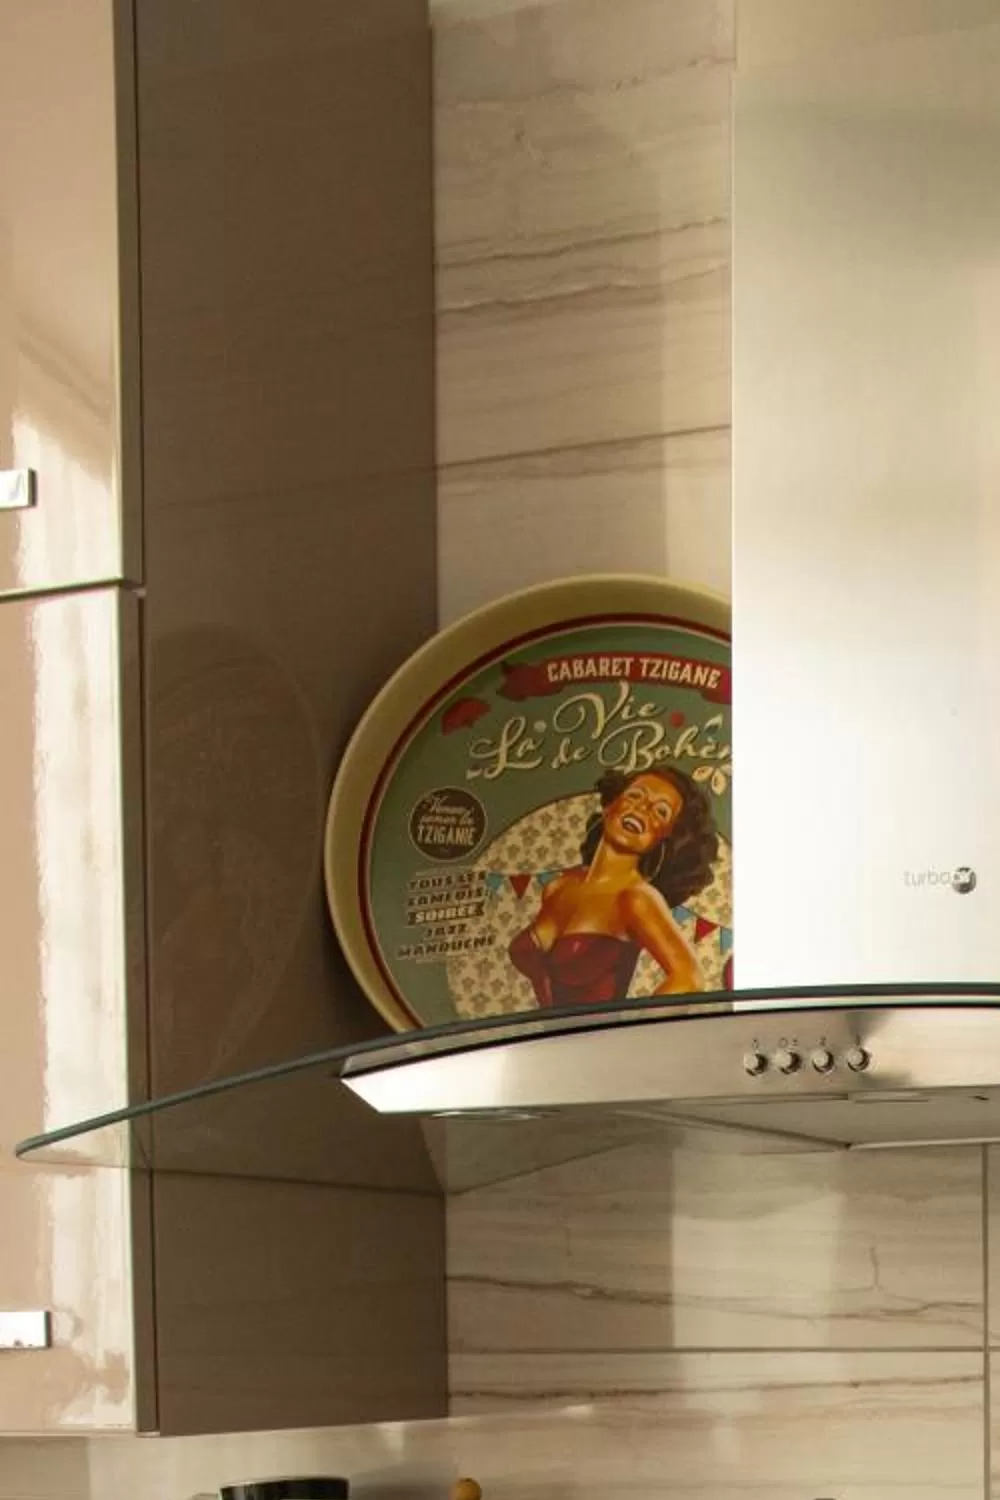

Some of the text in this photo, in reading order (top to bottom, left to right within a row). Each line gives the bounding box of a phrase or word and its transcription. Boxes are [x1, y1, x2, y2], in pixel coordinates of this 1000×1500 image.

[546, 656, 722, 689] CABARET TZIGANE
[553, 679, 662, 740] Vie
[551, 736, 590, 769] de
